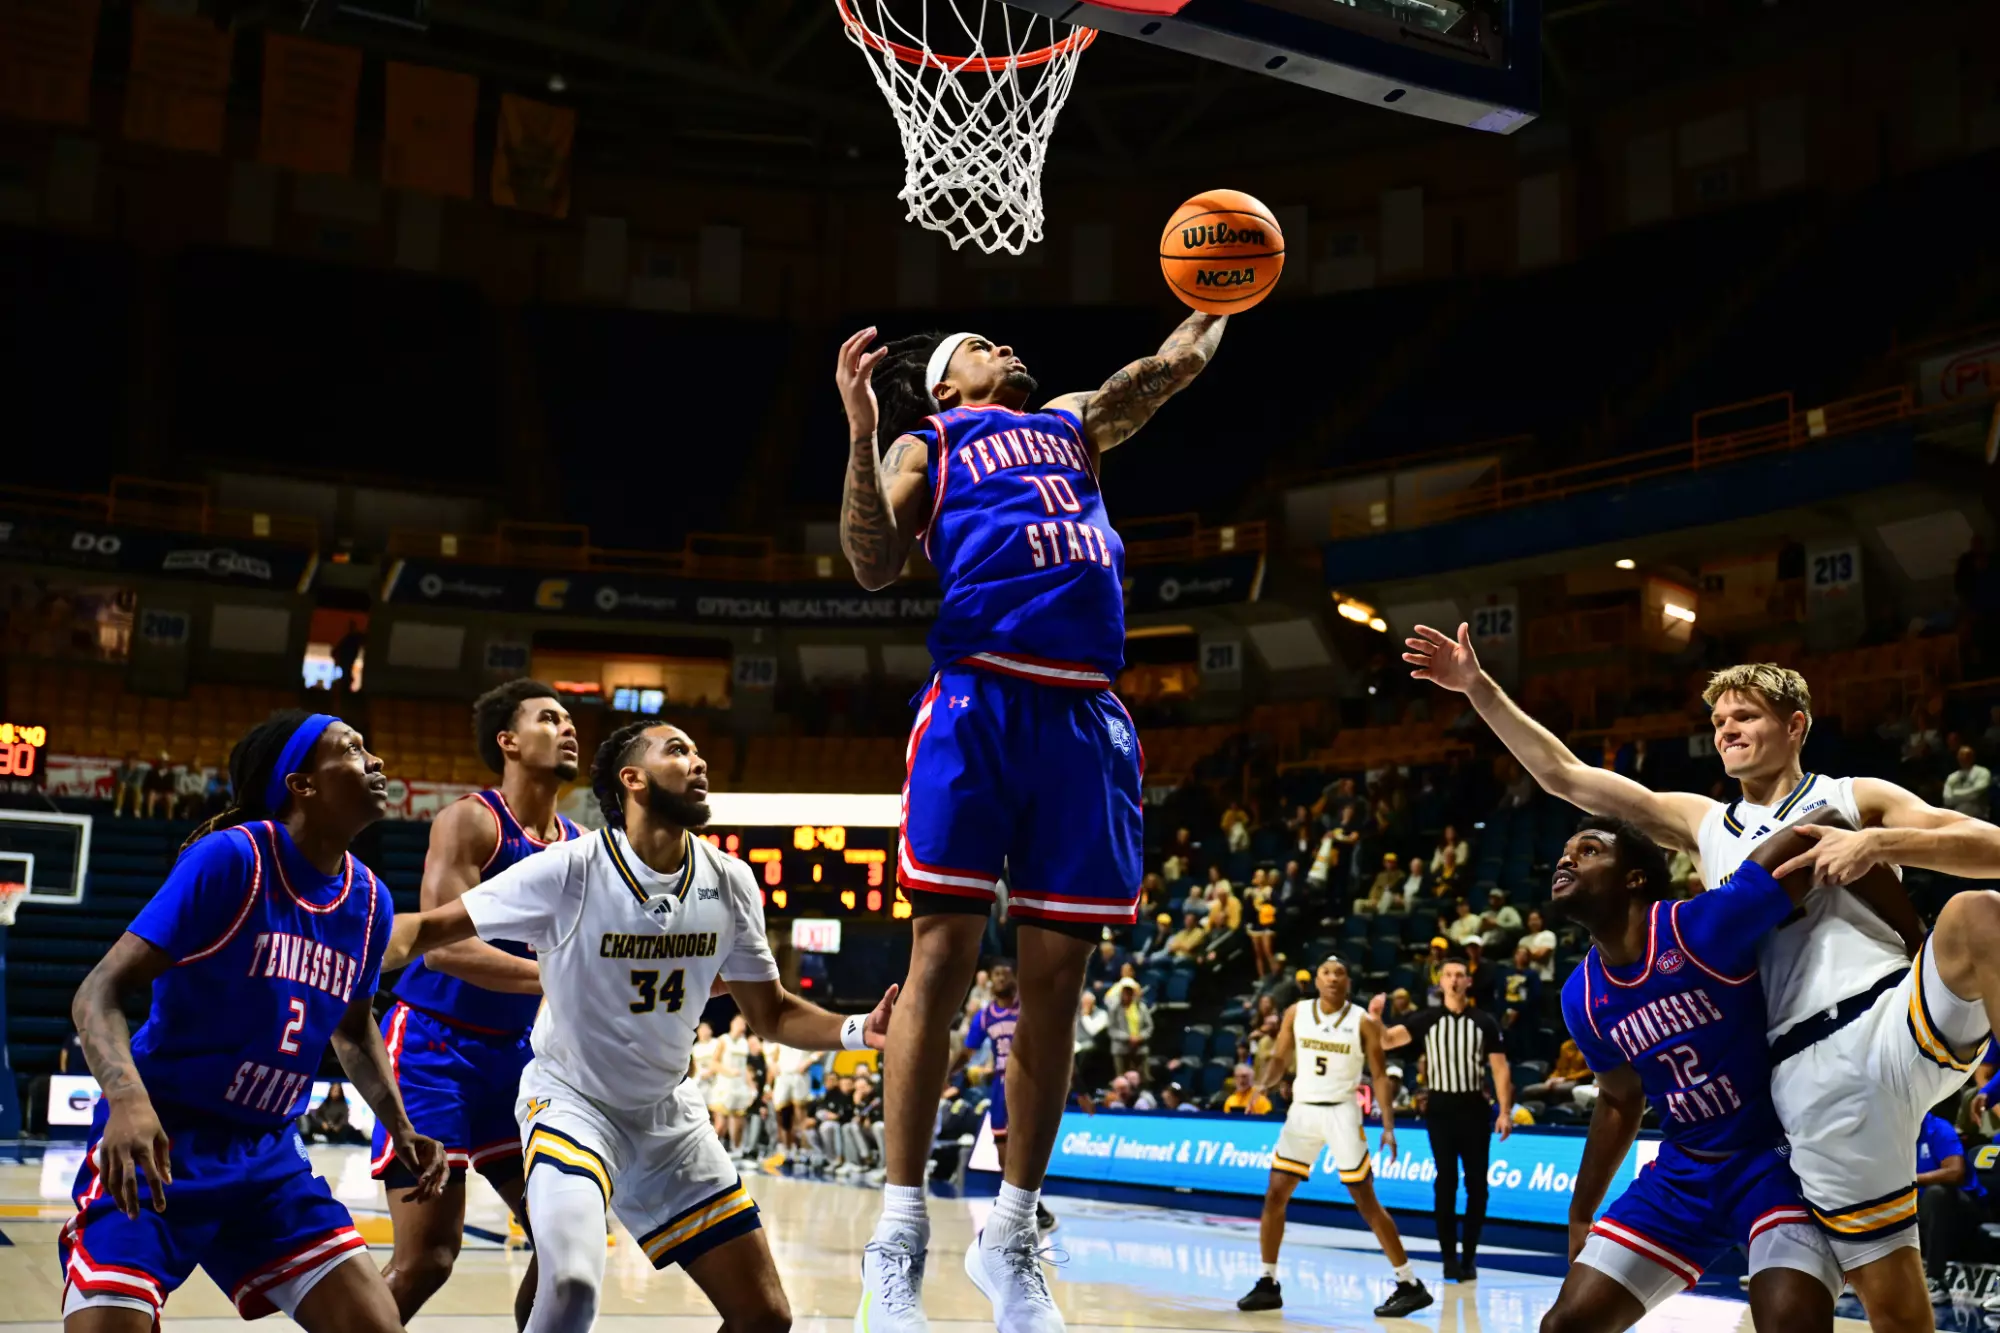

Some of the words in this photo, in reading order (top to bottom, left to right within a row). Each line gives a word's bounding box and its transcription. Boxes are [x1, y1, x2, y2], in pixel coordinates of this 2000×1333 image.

[1182, 222, 1265, 249] Wilson
[1195, 267, 1255, 287] NCAA
[958, 427, 1091, 484] TENNESSEE
[1020, 474, 1082, 516] 10
[72, 531, 121, 554] DO
[1025, 520, 1112, 569] STATE
[1814, 553, 1852, 584] 213
[697, 596, 772, 618] OFFICIAL
[780, 597, 893, 618] HEALTHCARE
[1477, 609, 1512, 636] 212
[248, 932, 358, 1004] TENNESSEE
[600, 932, 718, 960] CHATTANOOGA
[629, 967, 685, 1014] 34
[278, 996, 307, 1056] 2
[1609, 988, 1723, 1062] TENNESSEE
[225, 1060, 310, 1117] STATE
[1315, 1056, 1327, 1076] 5
[1656, 1044, 1708, 1090] 12
[1665, 1074, 1742, 1124] STATE
[1062, 1131, 1116, 1157] Official
[1114, 1135, 1176, 1162] Internet
[1176, 1139, 1191, 1163] &
[1194, 1140, 1221, 1165] TV
[1487, 1158, 1522, 1189] Go
